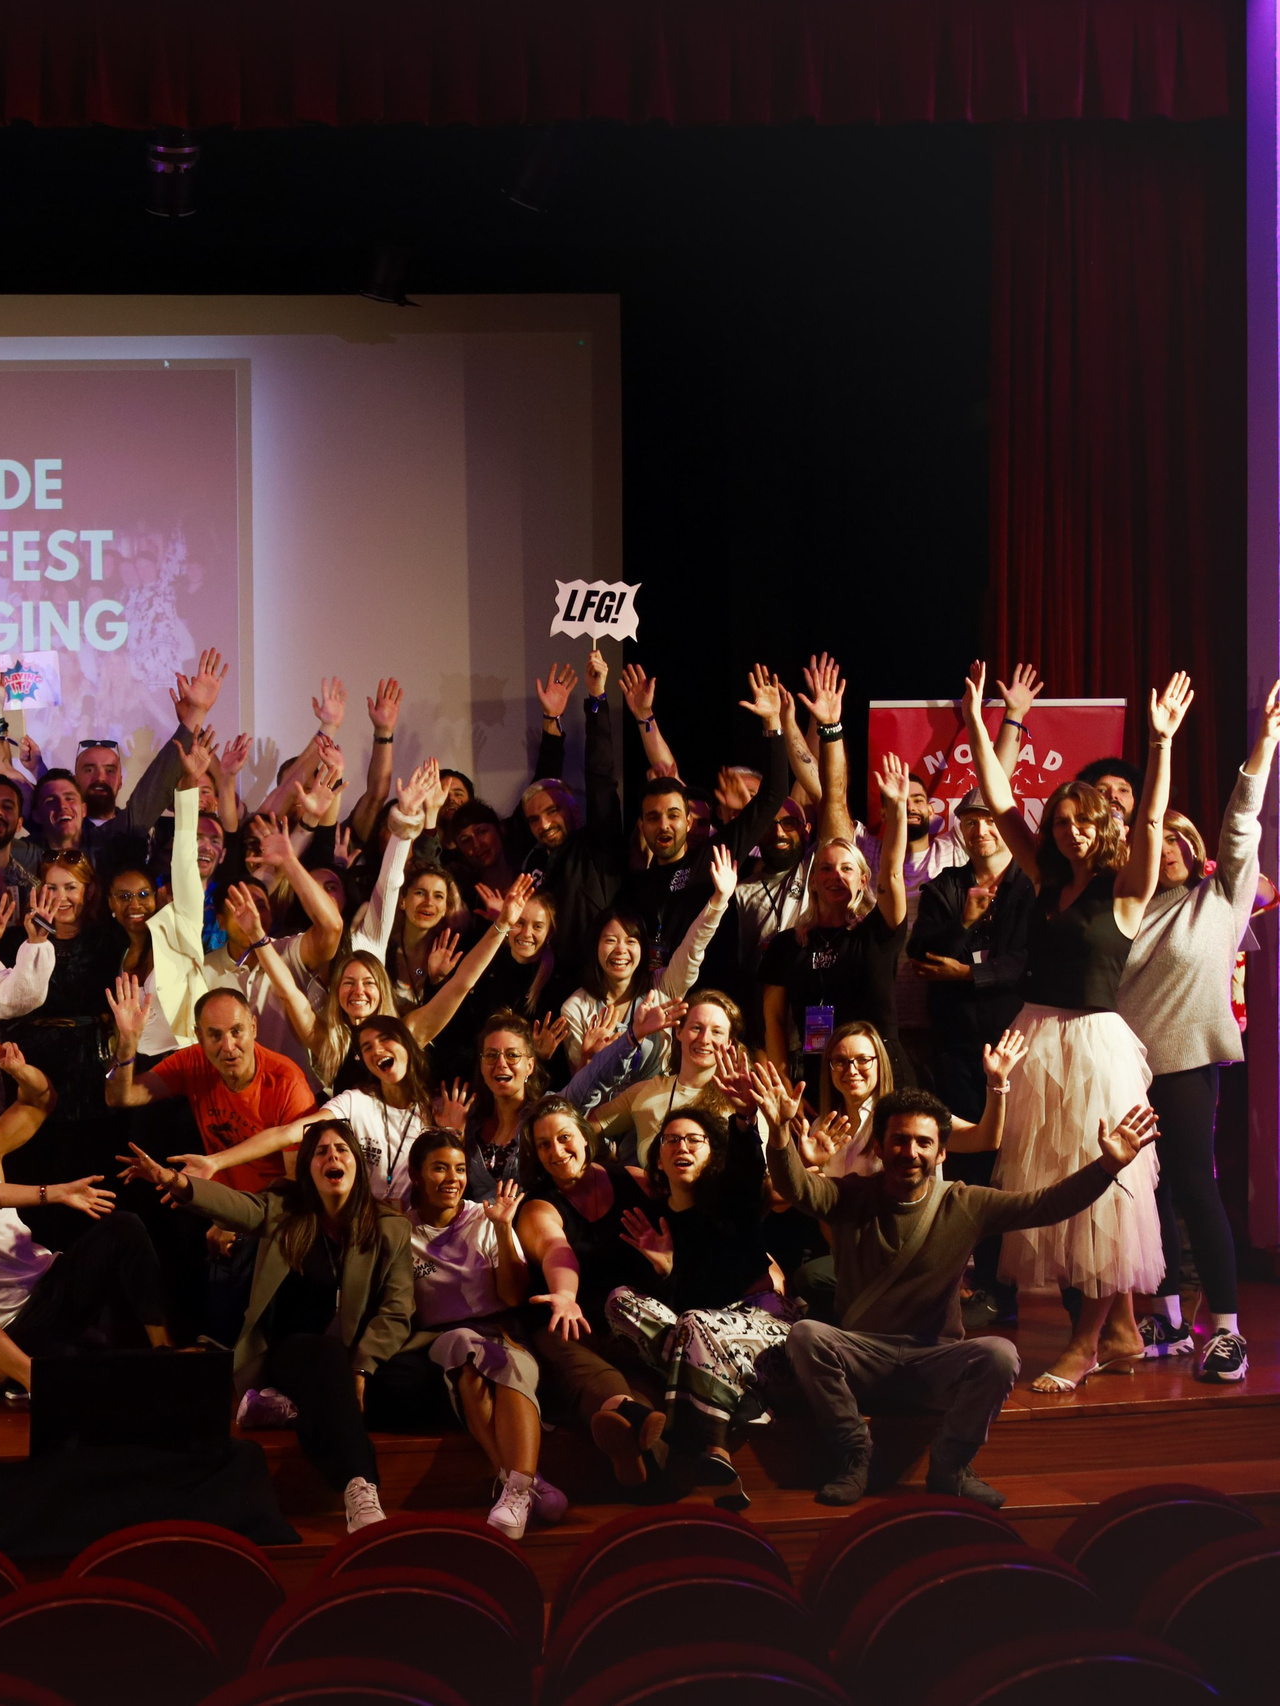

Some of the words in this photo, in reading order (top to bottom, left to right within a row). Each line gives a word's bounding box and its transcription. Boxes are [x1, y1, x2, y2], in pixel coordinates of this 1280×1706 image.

[562, 589, 627, 624] LFG!
[3, 672, 44, 684] LAYING
[10, 681, 32, 694] IT!
[923, 743, 1064, 776] NOAD
